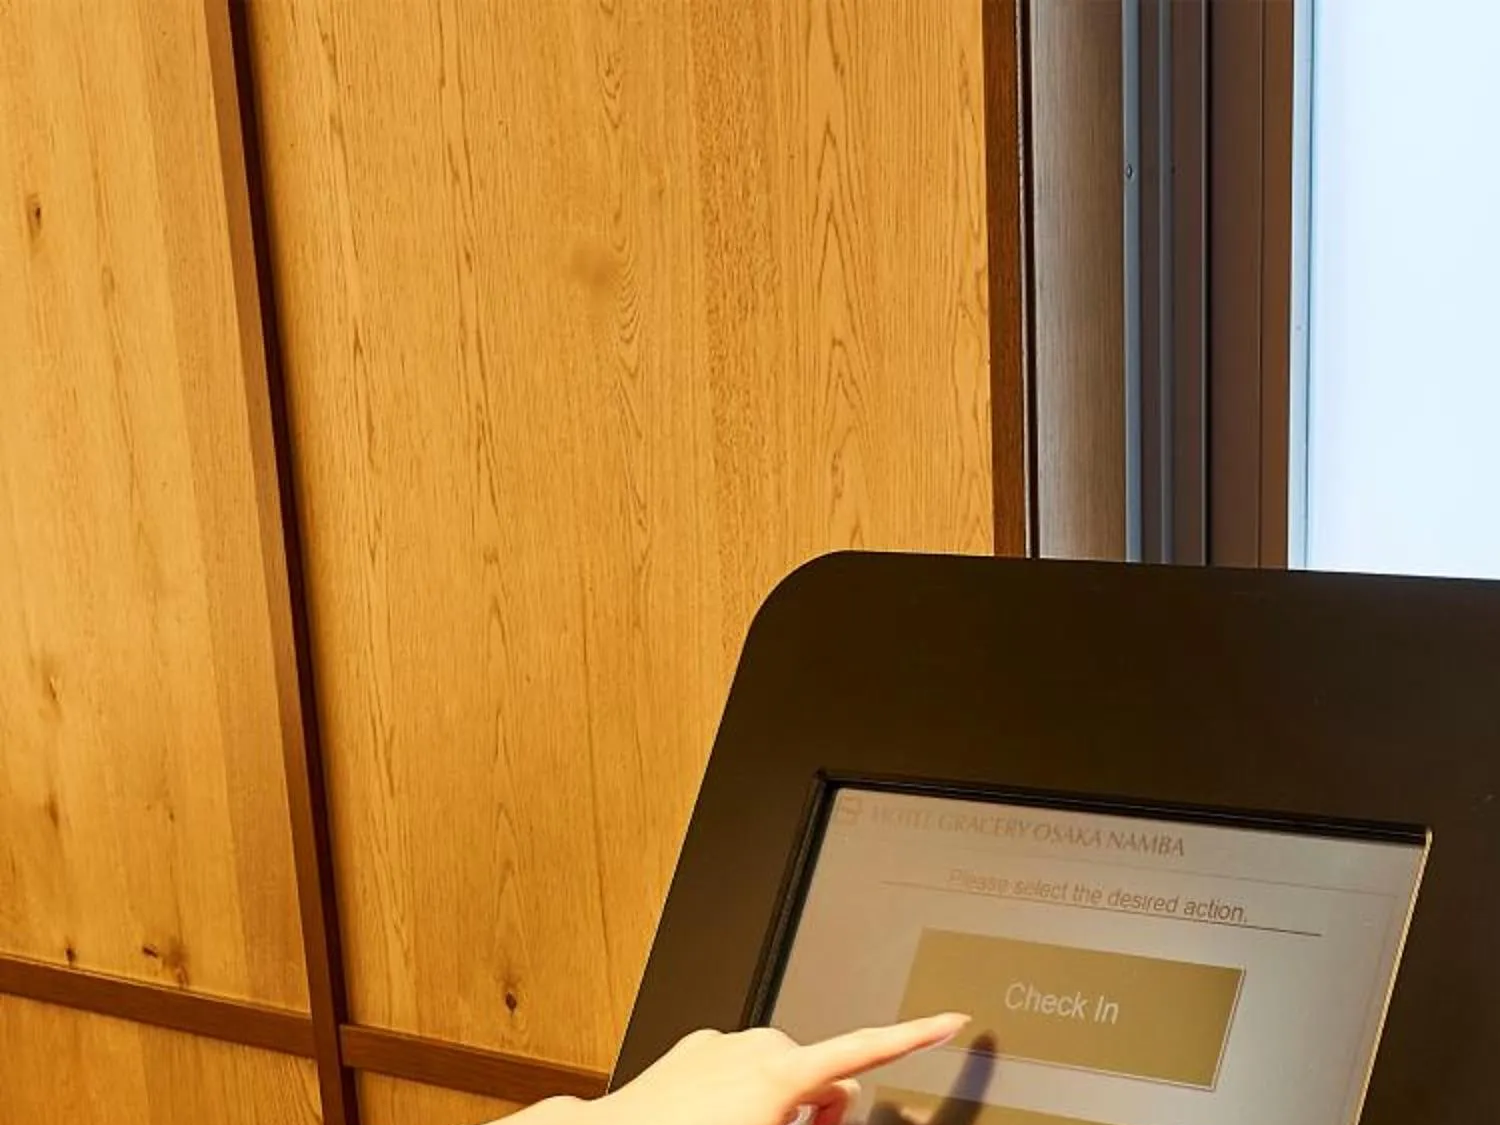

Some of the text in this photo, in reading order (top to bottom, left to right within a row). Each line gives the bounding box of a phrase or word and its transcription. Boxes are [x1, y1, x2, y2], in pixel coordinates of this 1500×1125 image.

[938, 812, 1034, 839] GRACERY
[1033, 823, 1101, 849] OSAKA
[1101, 831, 1185, 858] NAMBA
[948, 868, 1249, 923] Please select the desired action.
[1004, 981, 1120, 1025] Check In
